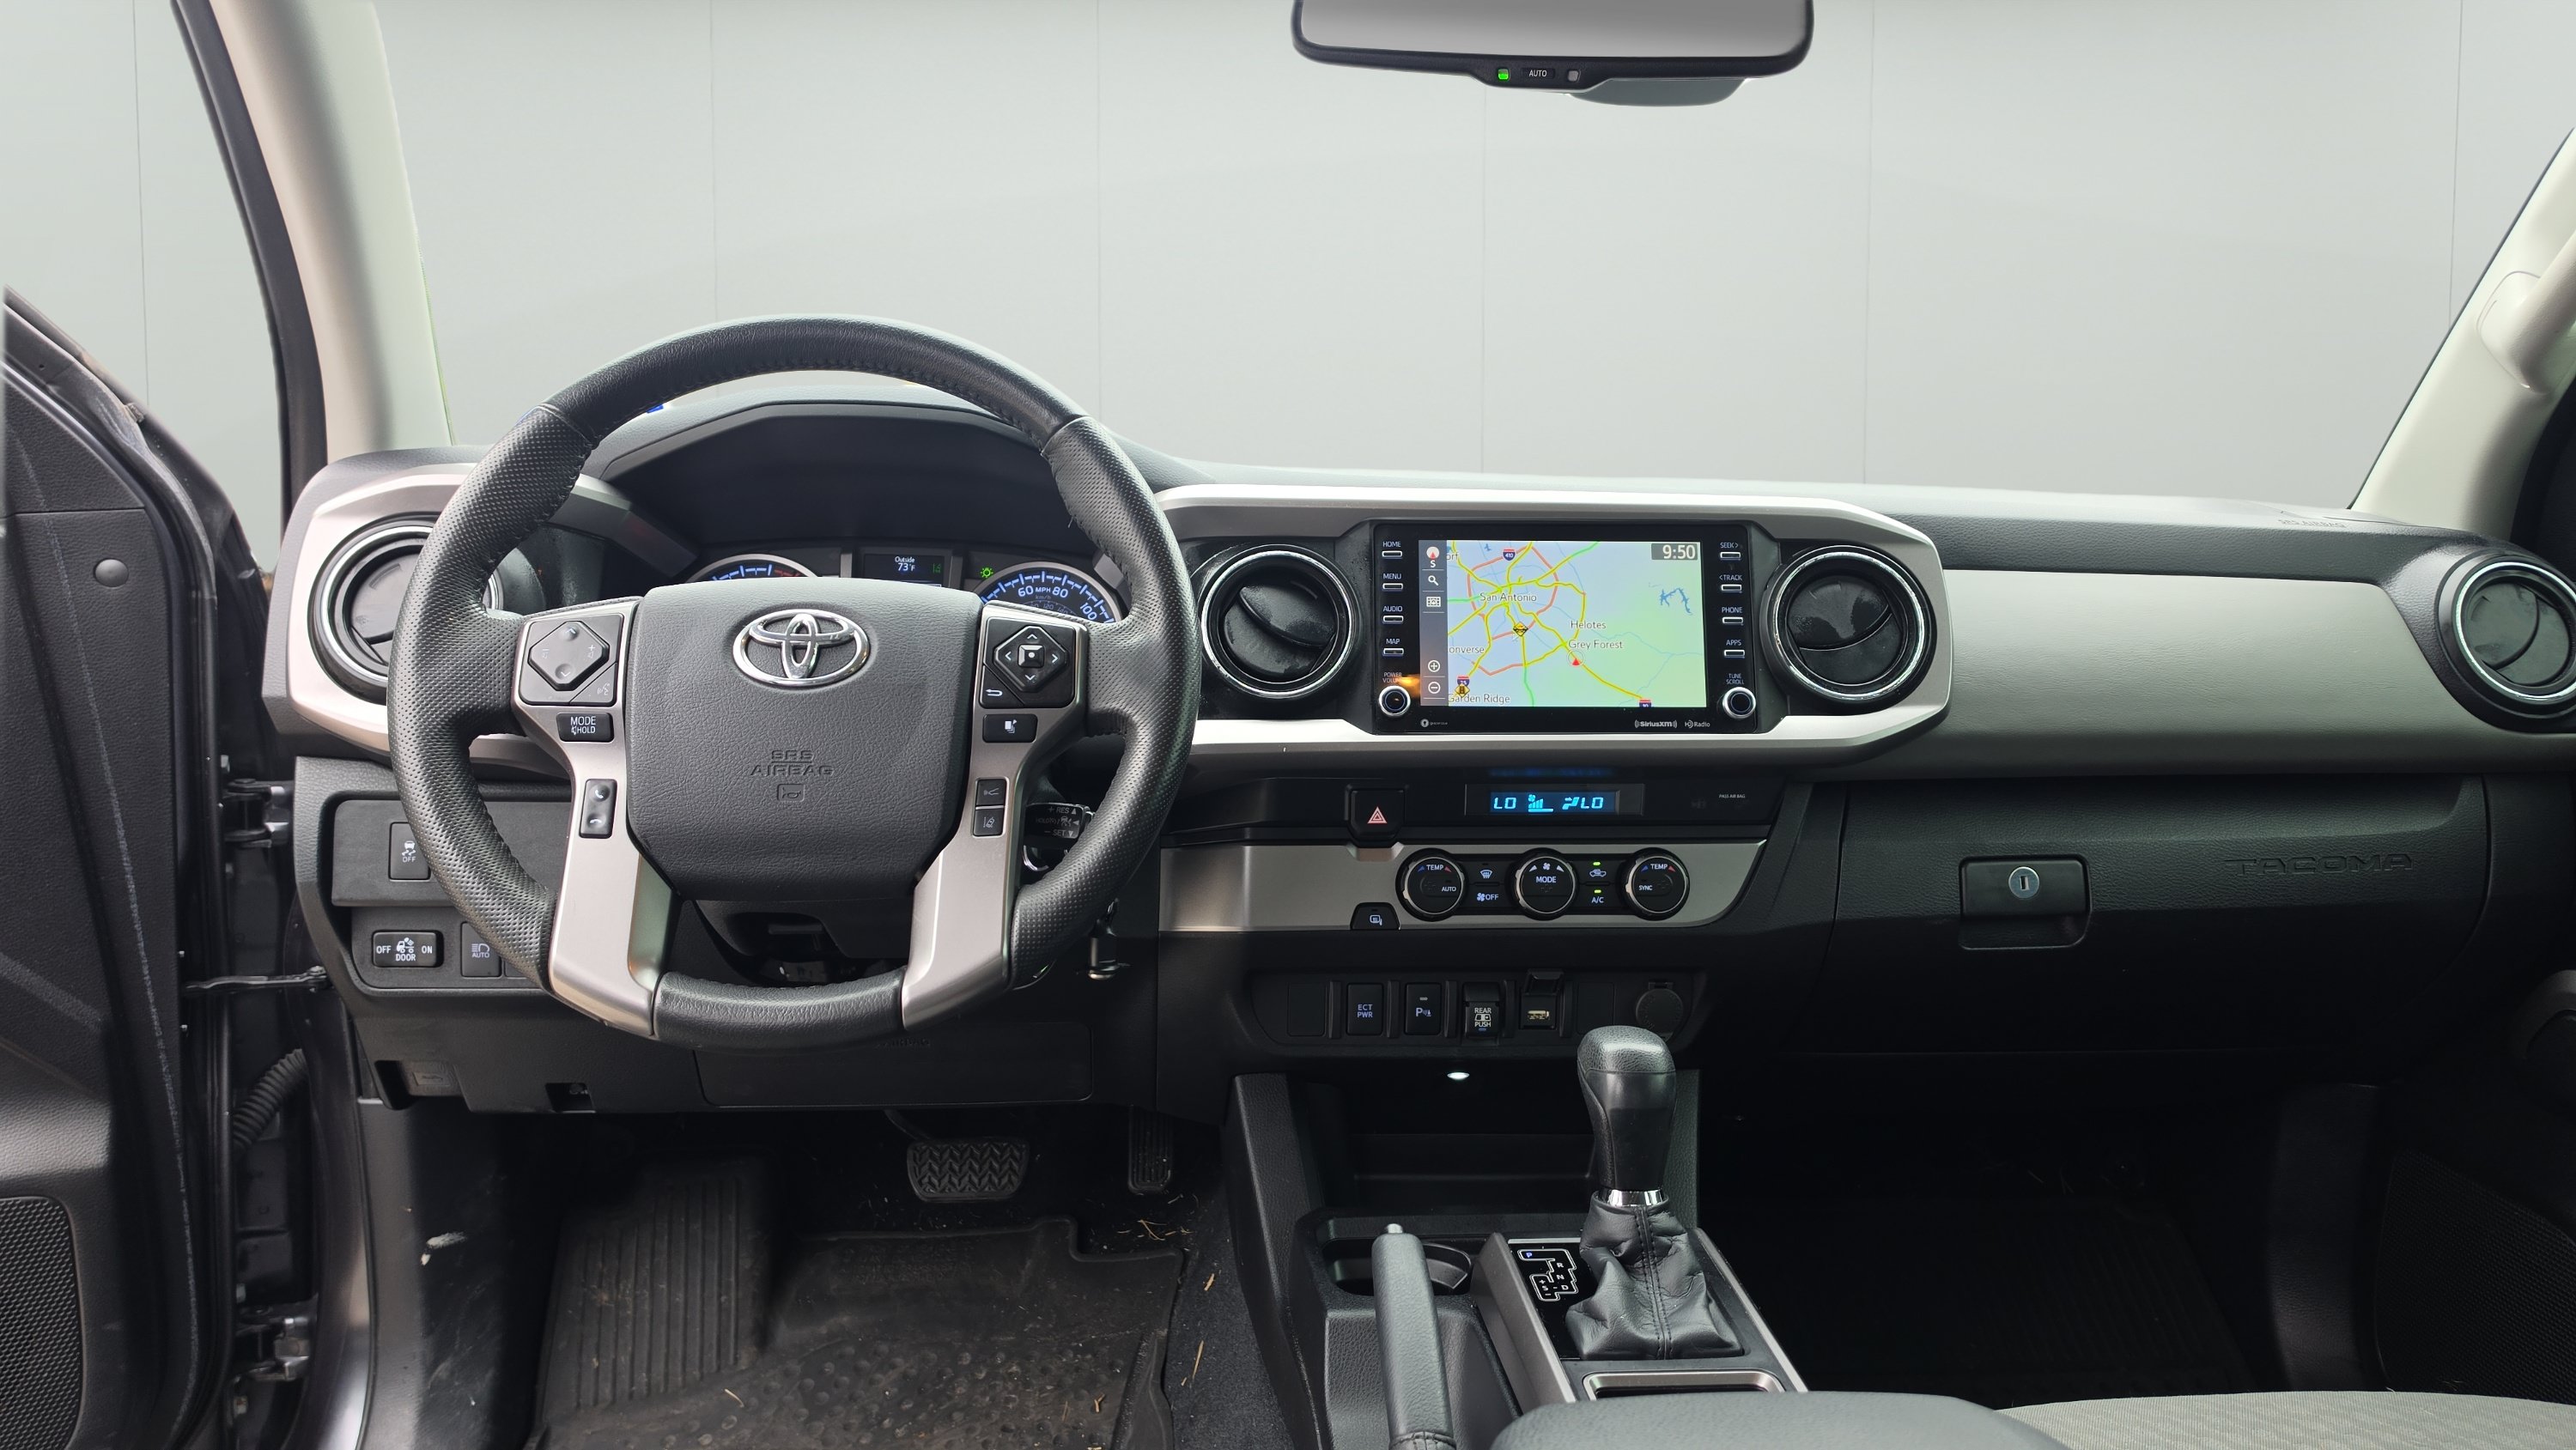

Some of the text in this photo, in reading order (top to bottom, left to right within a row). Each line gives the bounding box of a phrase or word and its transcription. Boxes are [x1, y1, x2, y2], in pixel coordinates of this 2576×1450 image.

[1662, 544, 1696, 559] 9:50
[1018, 585, 1034, 598] 60
[1053, 587, 1068, 598] 80
[1480, 592, 1537, 602] San Antonio
[1079, 603, 1097, 621] 100
[1571, 621, 1607, 629] Helotes
[1569, 640, 1623, 650] Grey Forest
[1449, 694, 1510, 705] Garden Ridge
[570, 716, 597, 725] MODE
[750, 765, 834, 776] AIRBAG
[2225, 854, 2413, 876] TACOMA
